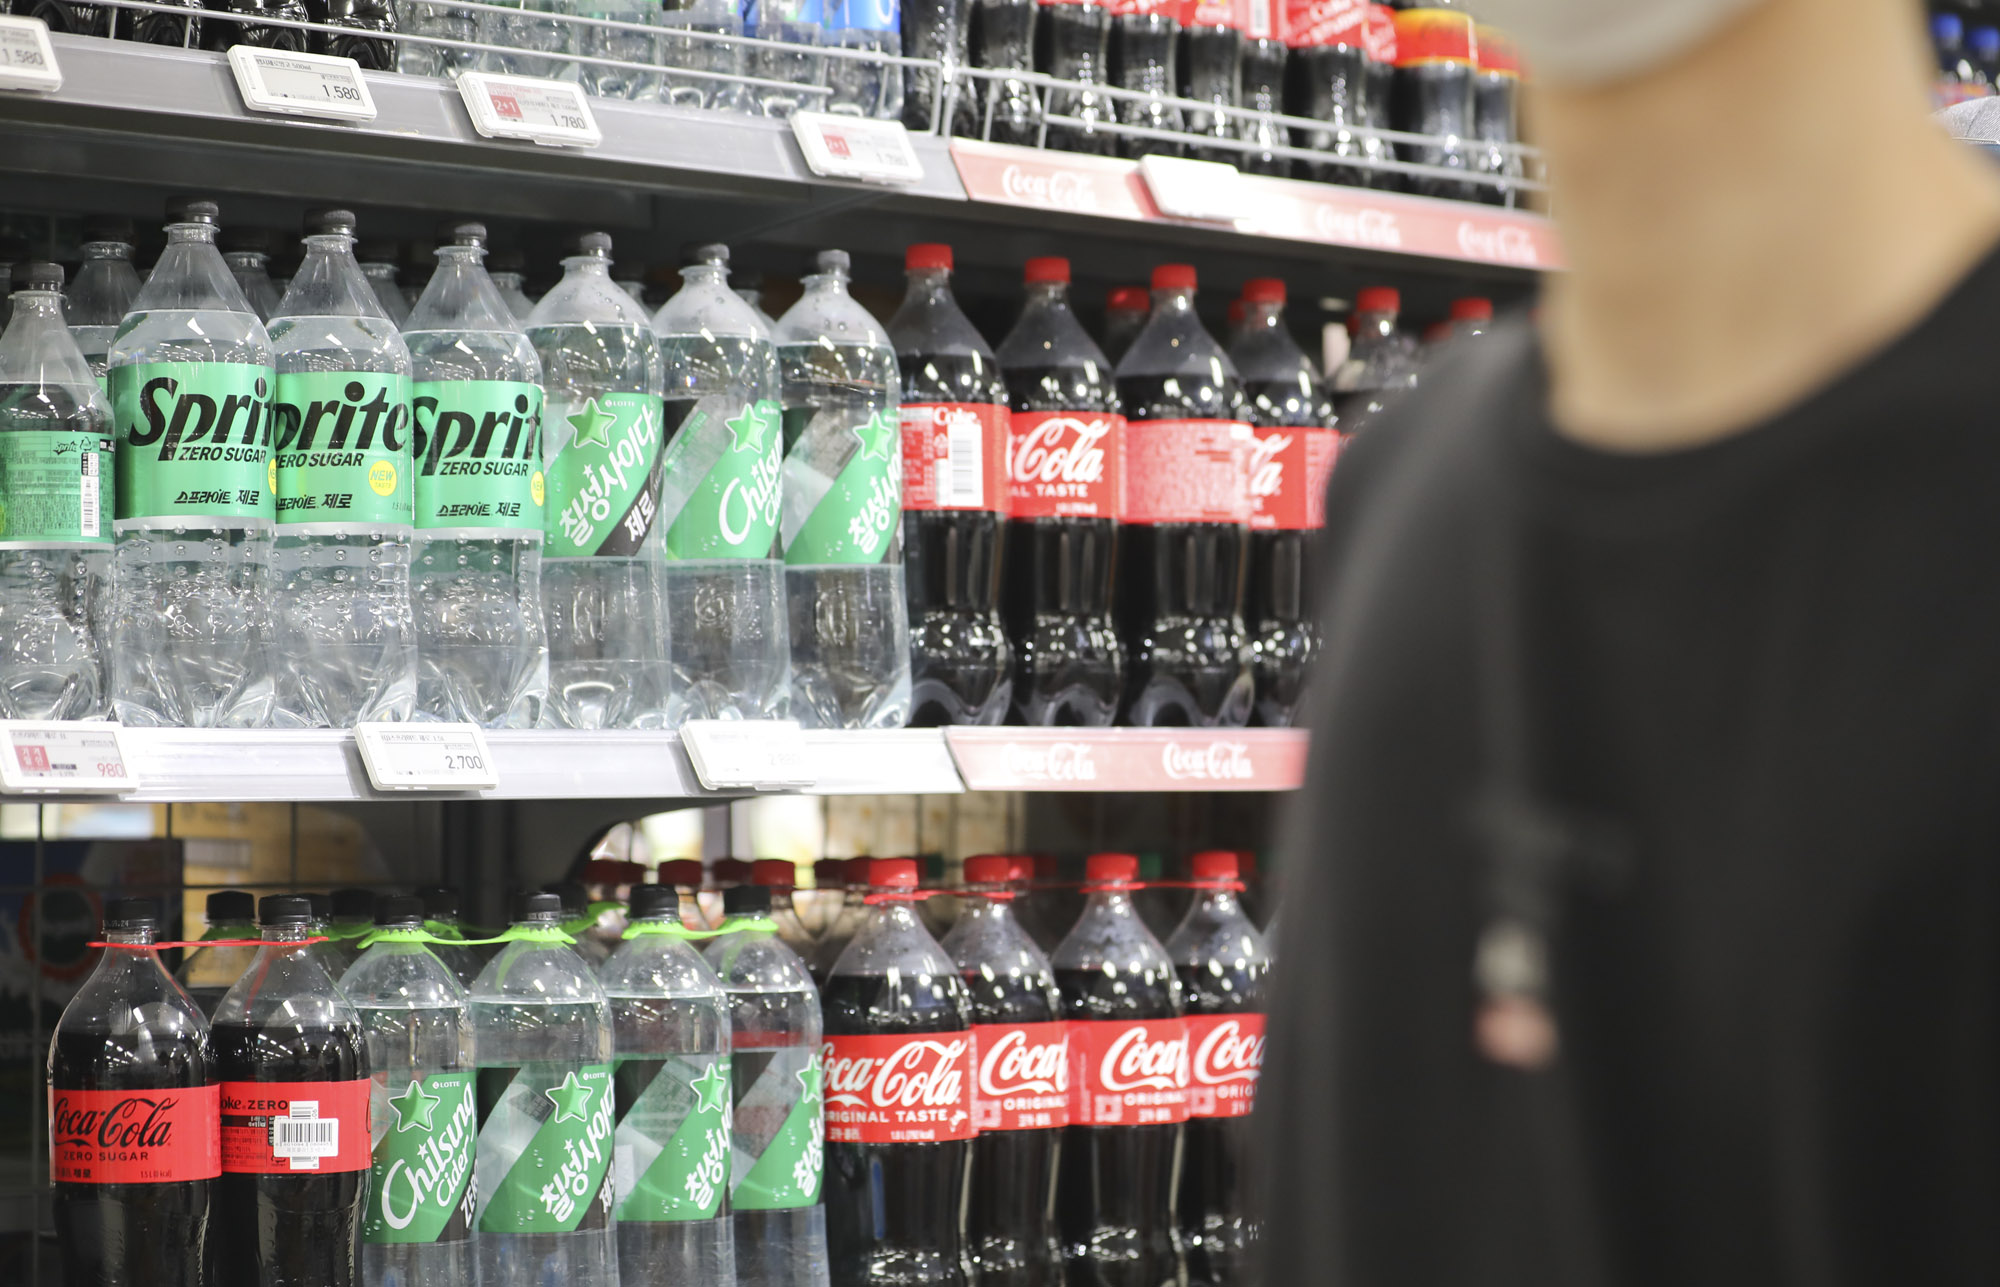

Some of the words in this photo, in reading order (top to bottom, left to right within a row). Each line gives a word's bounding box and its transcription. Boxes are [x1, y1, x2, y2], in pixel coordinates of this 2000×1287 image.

[613, 399, 636, 408] LOTTE
[129, 377, 276, 461] Sprit
[413, 394, 543, 477] Sprit
[178, 447, 222, 462] ZERO
[223, 448, 266, 463] SUGAR
[308, 452, 364, 467] SUGAR
[370, 470, 394, 481] NEW
[440, 461, 482, 476] ZERO
[483, 462, 529, 477] SUGAR
[559, 403, 656, 547] 칠성사이다
[174, 489, 230, 505] 스프라이트
[236, 489, 259, 505] 제로
[1036, 483, 1088, 497] TASTE
[321, 493, 352, 509] 제로
[436, 501, 490, 517] 스프라이트
[495, 502, 521, 517] 제로
[624, 490, 655, 542] 제로
[97, 763, 125, 777] 980
[589, 1071, 606, 1080] LOTTE
[439, 1080, 461, 1089] LOTTE
[247, 1099, 289, 1110] ZERO
[895, 1109, 948, 1123] TASTE
[63, 1151, 93, 1161] ZERO
[99, 1151, 149, 1161] SUGAR
[381, 1082, 476, 1230] Chilsung
[436, 1134, 470, 1208] Cider
